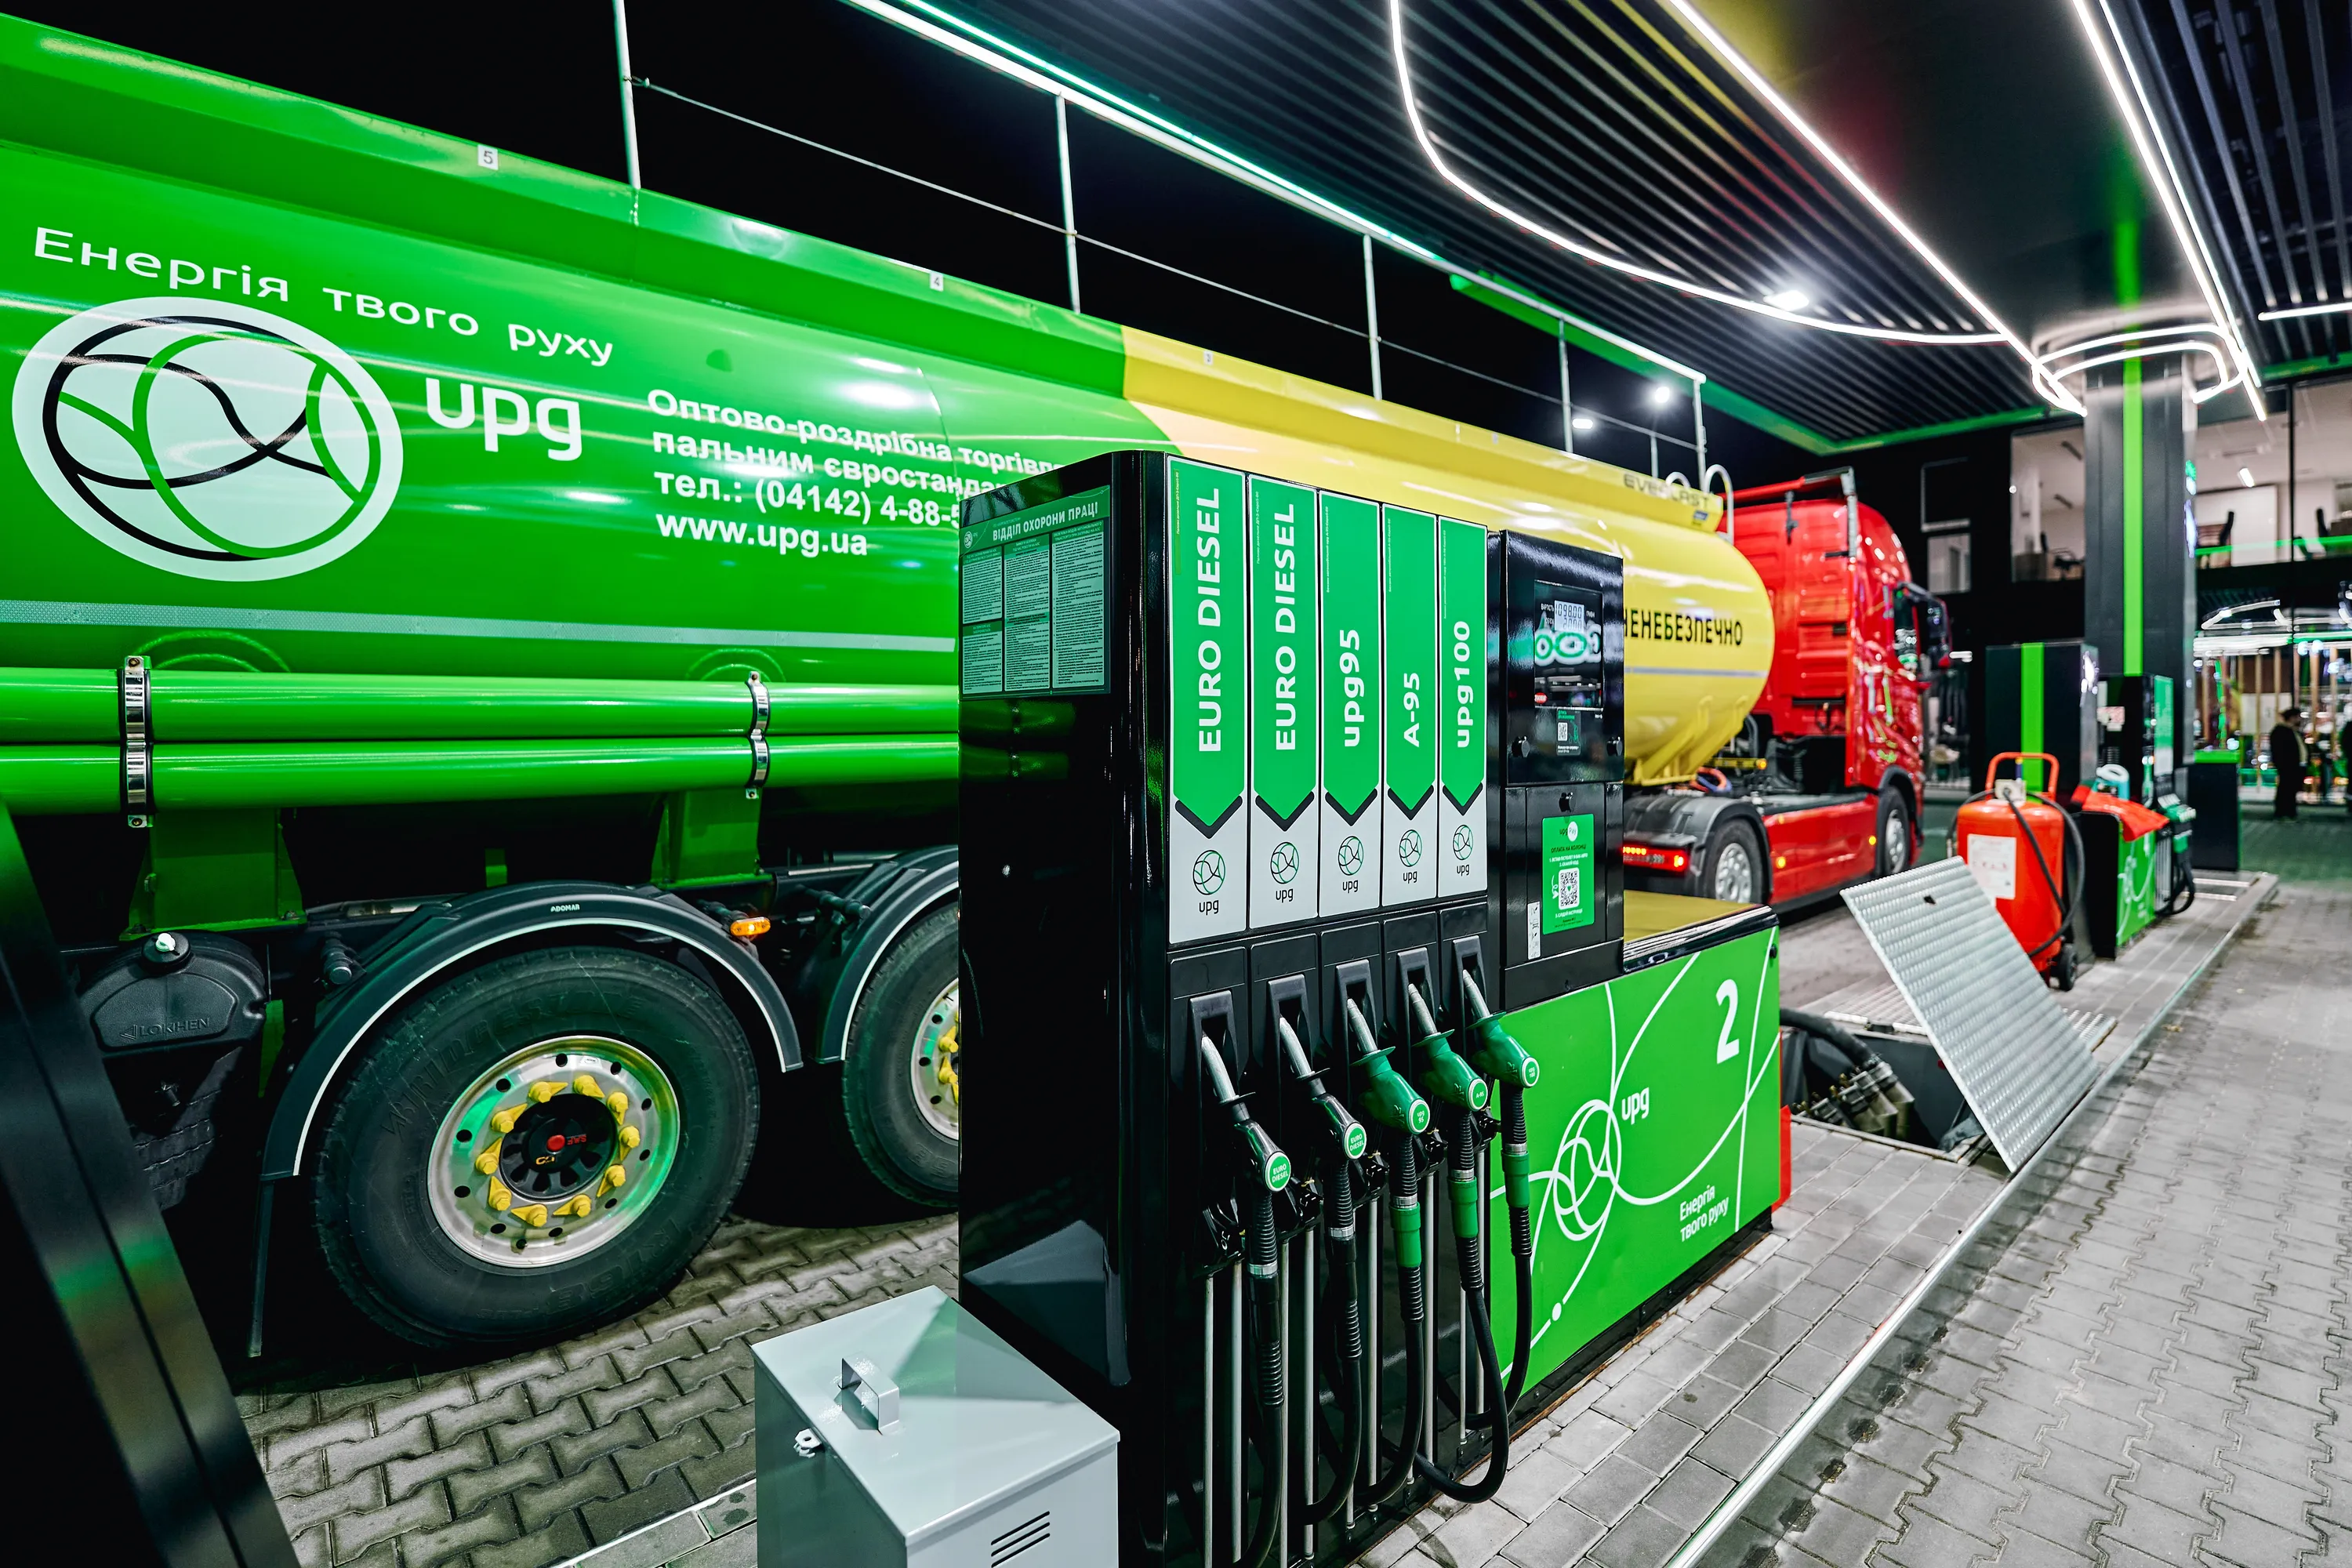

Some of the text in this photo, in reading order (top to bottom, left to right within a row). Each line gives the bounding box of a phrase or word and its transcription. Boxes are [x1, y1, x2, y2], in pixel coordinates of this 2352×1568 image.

[484, 151, 493, 164] 5
[34, 226, 614, 366] Енергія твого руху
[426, 378, 583, 461] upg
[648, 389, 1066, 476] Оптово-роздрібна торгівл
[652, 431, 1007, 499] пальним євростанда
[654, 471, 742, 503] тел.:
[755, 478, 871, 524] (04142)
[655, 514, 868, 558] www.upg.ua
[993, 523, 1021, 541] ВІДДІЛ
[1023, 511, 1065, 532] ОХОРОНИ
[1068, 502, 1098, 517] ПРАЦІ
[1196, 488, 1221, 752] EURO DIESEL
[1274, 503, 1297, 750] EURO DIESEL
[1339, 629, 1365, 747] upg95
[1454, 621, 1474, 748] upg100
[1342, 879, 1359, 894] upg
[1403, 870, 1417, 884] upg
[1456, 863, 1470, 876] upg
[1199, 899, 1219, 915] upg
[1276, 887, 1294, 903] upg
[1715, 978, 1740, 1064] 2
[1621, 1087, 1650, 1125] upg
[567, 1134, 587, 1145] SAF
[1349, 1140, 1364, 1151] DIESEL
[1351, 1134, 1363, 1144] EURO
[1272, 1163, 1287, 1175] EURO
[1272, 1171, 1289, 1182] DIESEL
[1680, 1185, 1715, 1221] Енергія
[1680, 1196, 1730, 1242] твого руху
